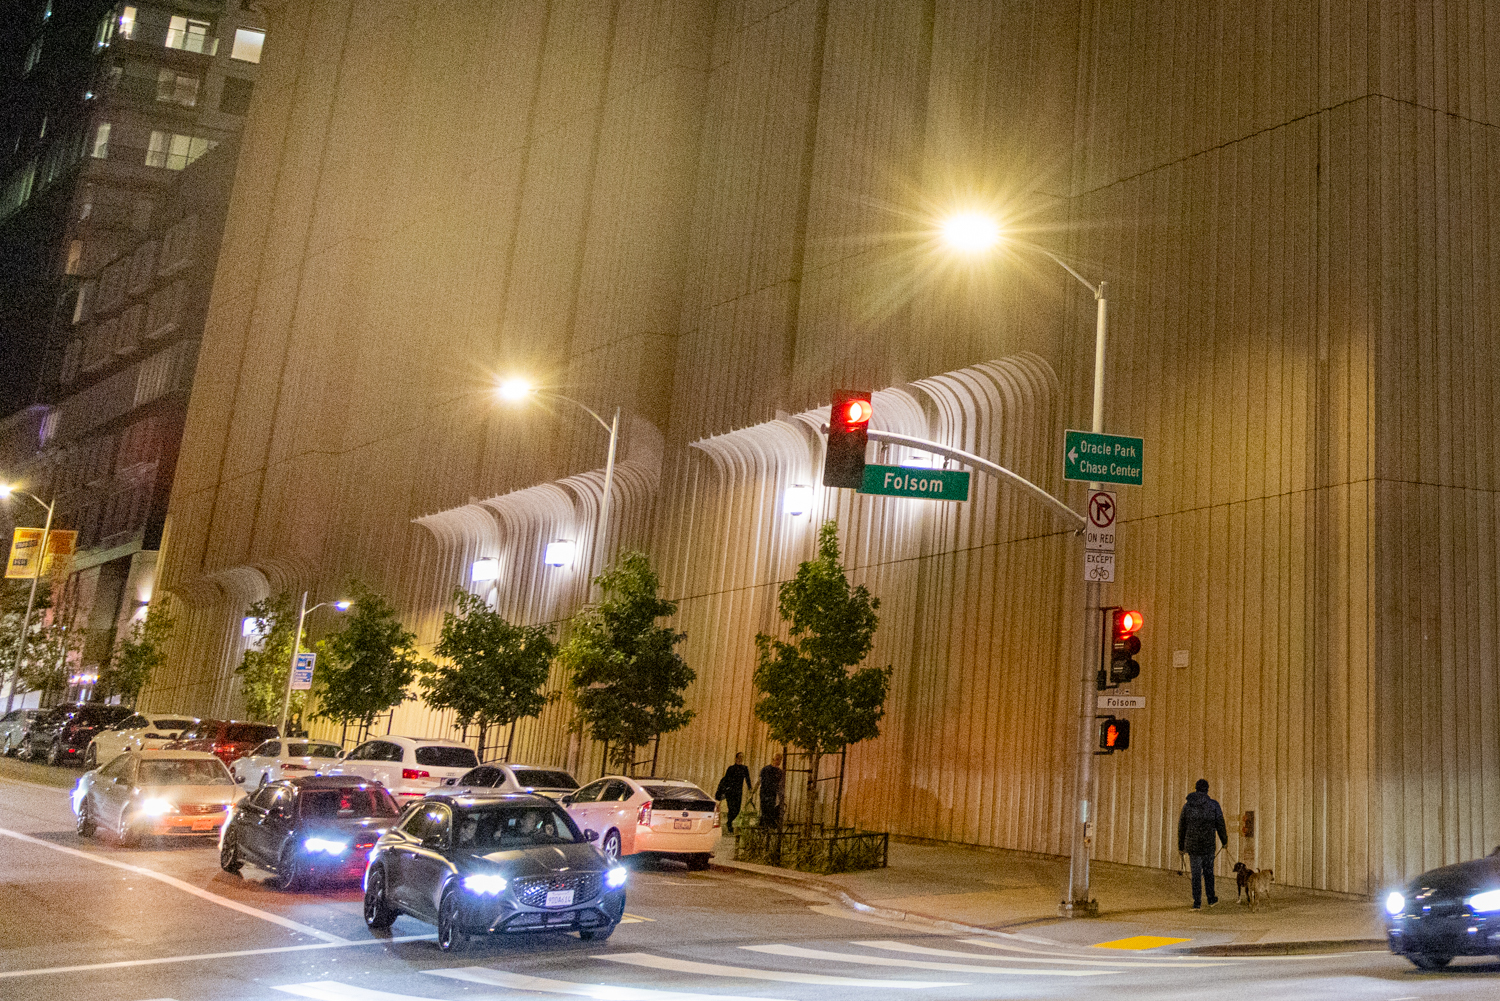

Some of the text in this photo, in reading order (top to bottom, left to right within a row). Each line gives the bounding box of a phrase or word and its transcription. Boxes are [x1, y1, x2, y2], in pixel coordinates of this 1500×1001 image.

[1080, 440, 1136, 457] Oracle Park
[1080, 460, 1141, 478] Chase Center
[884, 472, 943, 493] Folsom
[1087, 532, 1114, 544] ON RED
[1086, 554, 1113, 564] EXCEPT
[1107, 698, 1137, 707] Folsom
